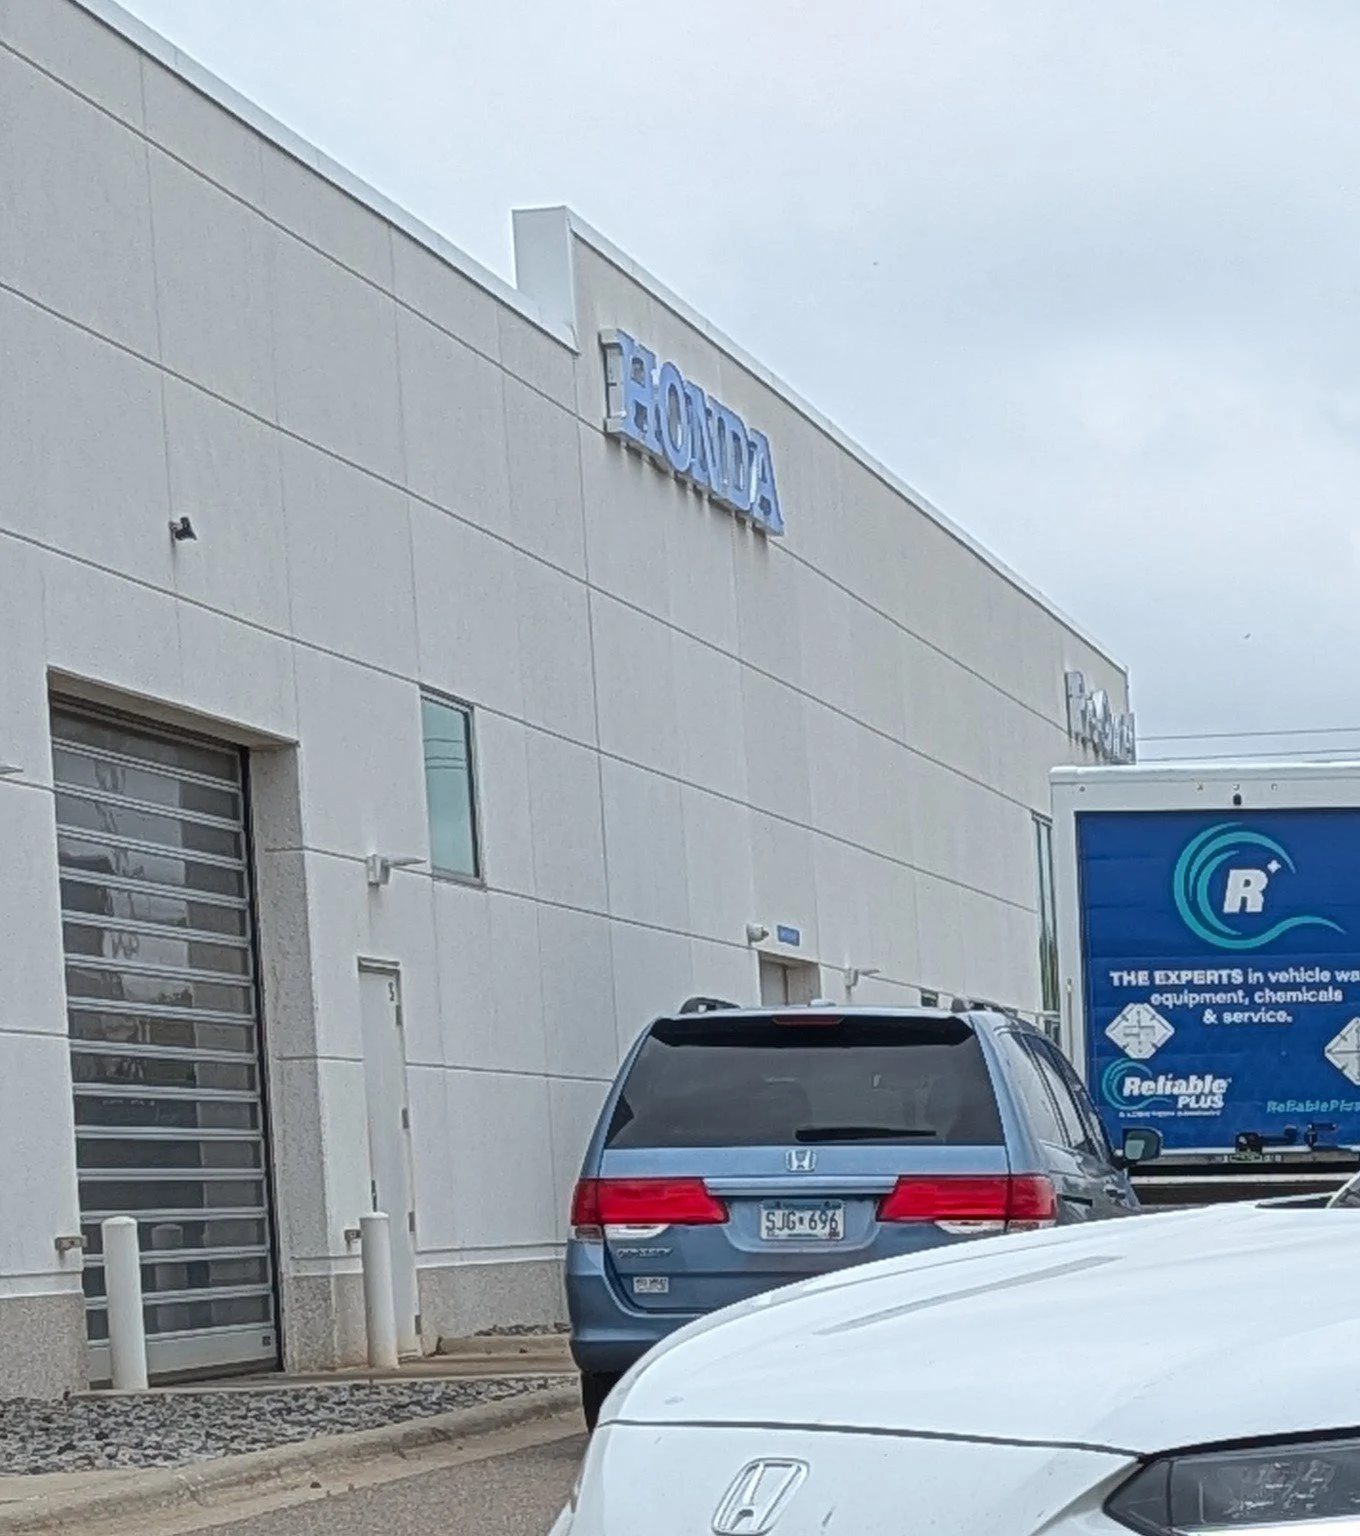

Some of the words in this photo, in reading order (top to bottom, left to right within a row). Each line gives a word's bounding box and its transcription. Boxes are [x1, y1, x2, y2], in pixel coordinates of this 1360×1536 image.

[600, 328, 784, 536] HONDA
[1223, 869, 1268, 913] R
[1110, 970, 1150, 986] THE
[1154, 969, 1244, 985] EXPERTS
[1248, 968, 1264, 984] in
[1268, 967, 1331, 983] vehicle
[1151, 988, 1249, 1008] equipment,
[1254, 986, 1343, 1003] chemicals
[1203, 1009, 1218, 1024] &
[1223, 1006, 1293, 1023] service.
[1123, 1074, 1229, 1097] Reliable
[1177, 1095, 1224, 1108] PLUS
